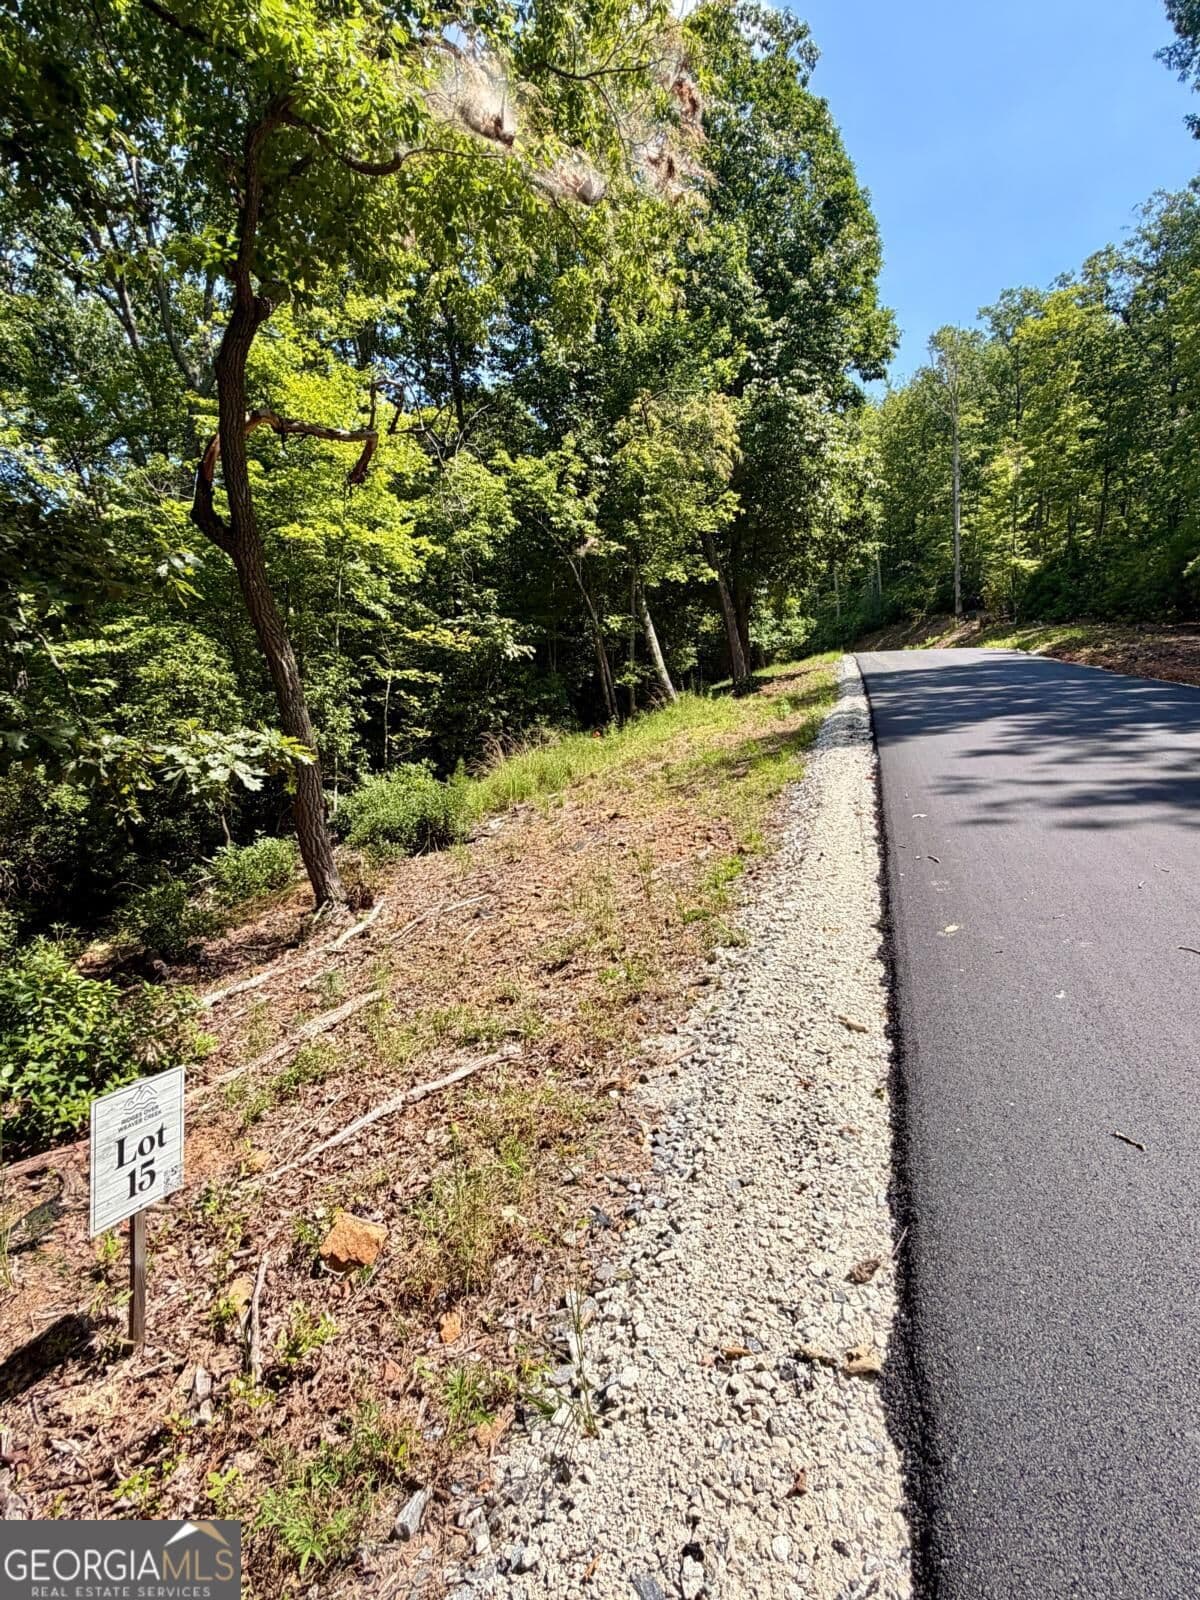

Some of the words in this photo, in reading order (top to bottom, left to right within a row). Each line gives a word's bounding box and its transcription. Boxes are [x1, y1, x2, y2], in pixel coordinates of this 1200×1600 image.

[118, 1118, 142, 1132] WEAVER
[144, 1110, 162, 1121] CREEK
[115, 1122, 167, 1171] Lot
[127, 1157, 156, 1201] 15
